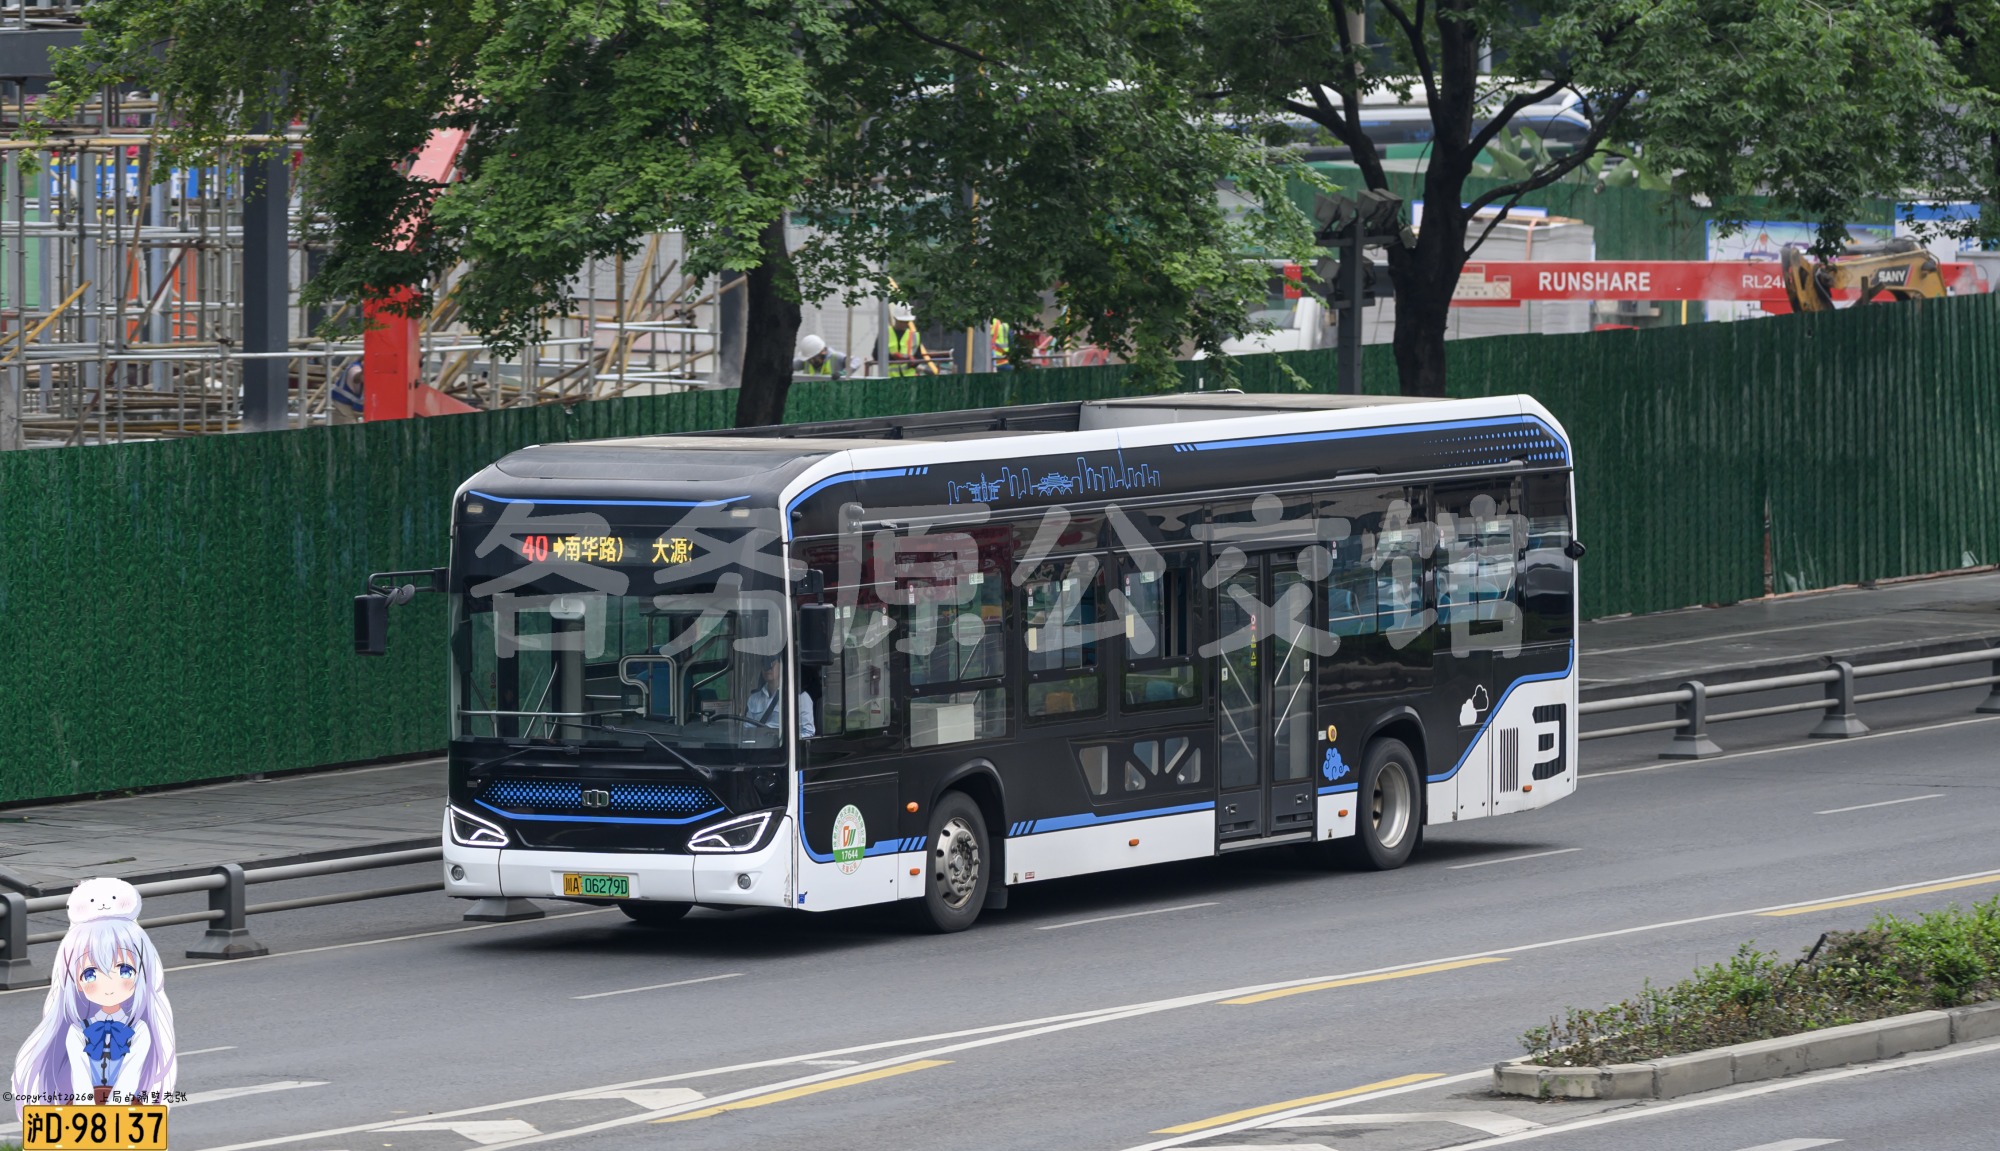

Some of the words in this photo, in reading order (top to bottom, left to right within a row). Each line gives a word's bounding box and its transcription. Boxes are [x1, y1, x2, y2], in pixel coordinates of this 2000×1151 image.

[1538, 271, 1651, 292] RUNSHARE
[1878, 270, 1907, 283] SANY
[521, 535, 549, 563] 40
[841, 849, 859, 860] 17644
